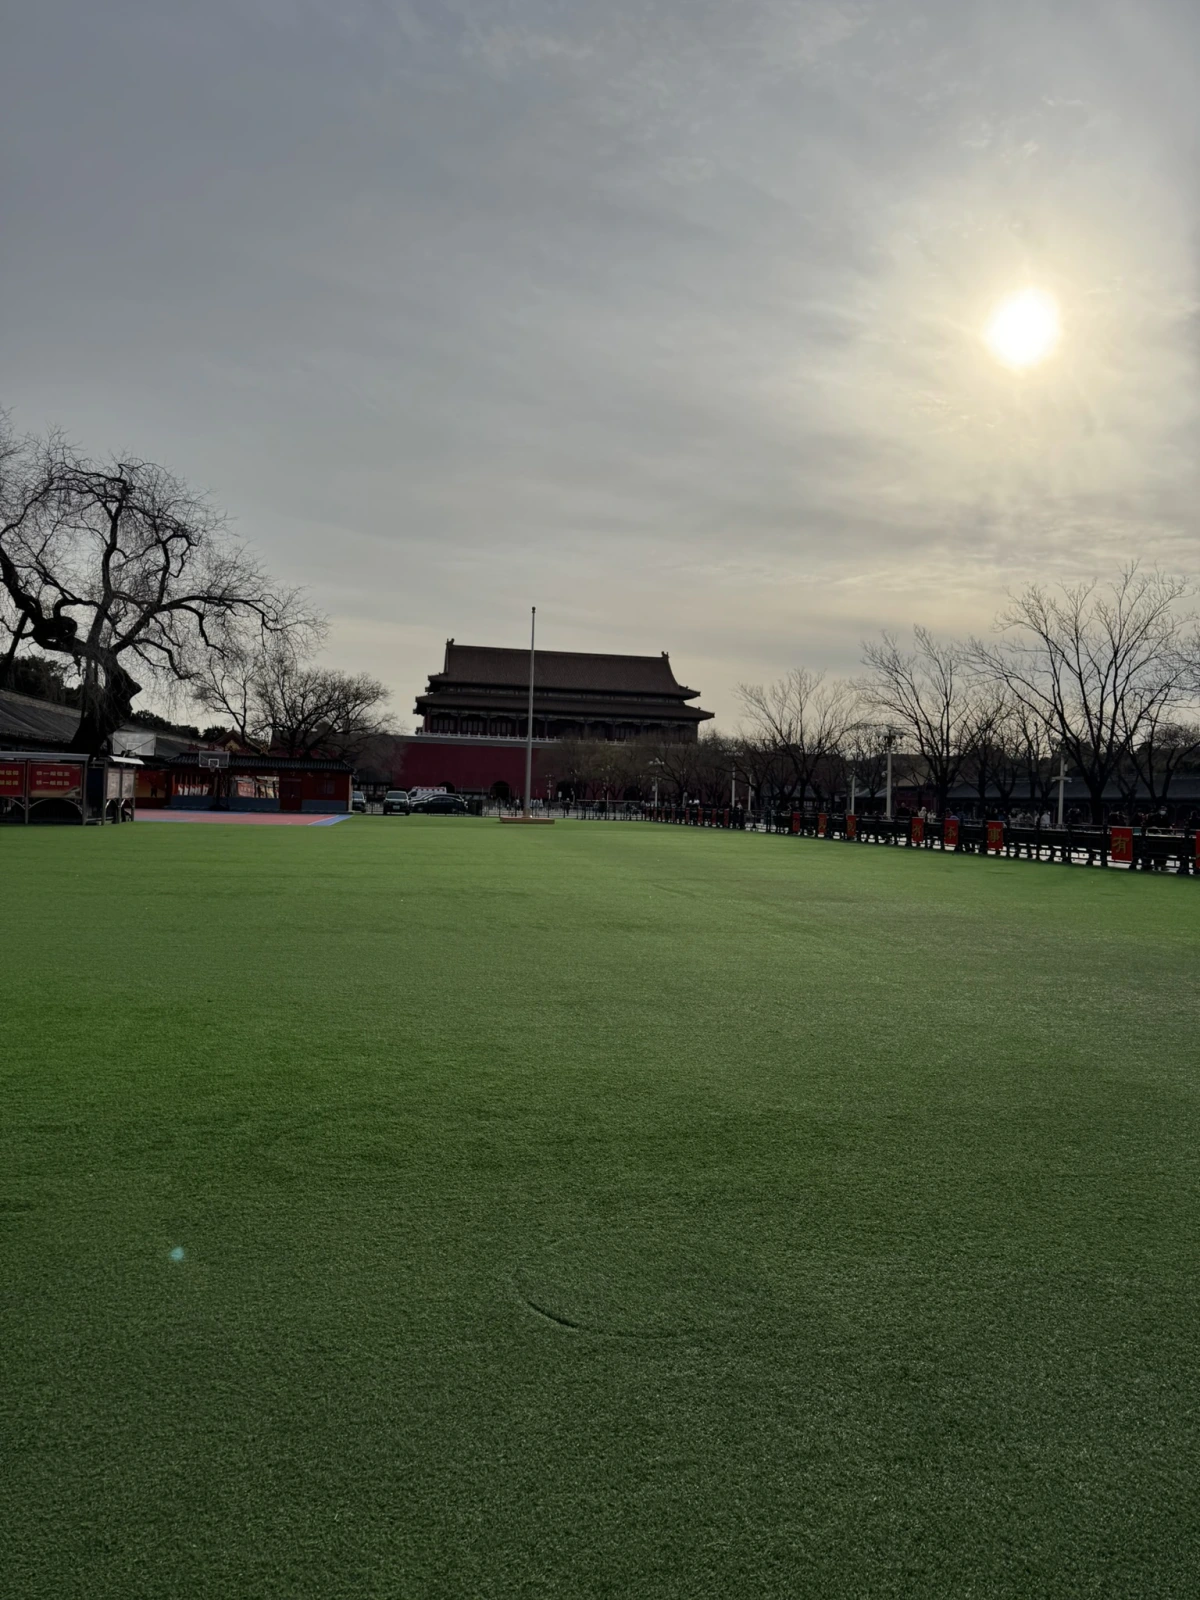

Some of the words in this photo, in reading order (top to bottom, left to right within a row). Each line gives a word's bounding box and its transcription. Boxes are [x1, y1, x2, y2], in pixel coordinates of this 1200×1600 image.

[947, 826, 957, 839] 本
[988, 827, 1001, 843] 事
[1112, 835, 1130, 854] 有
